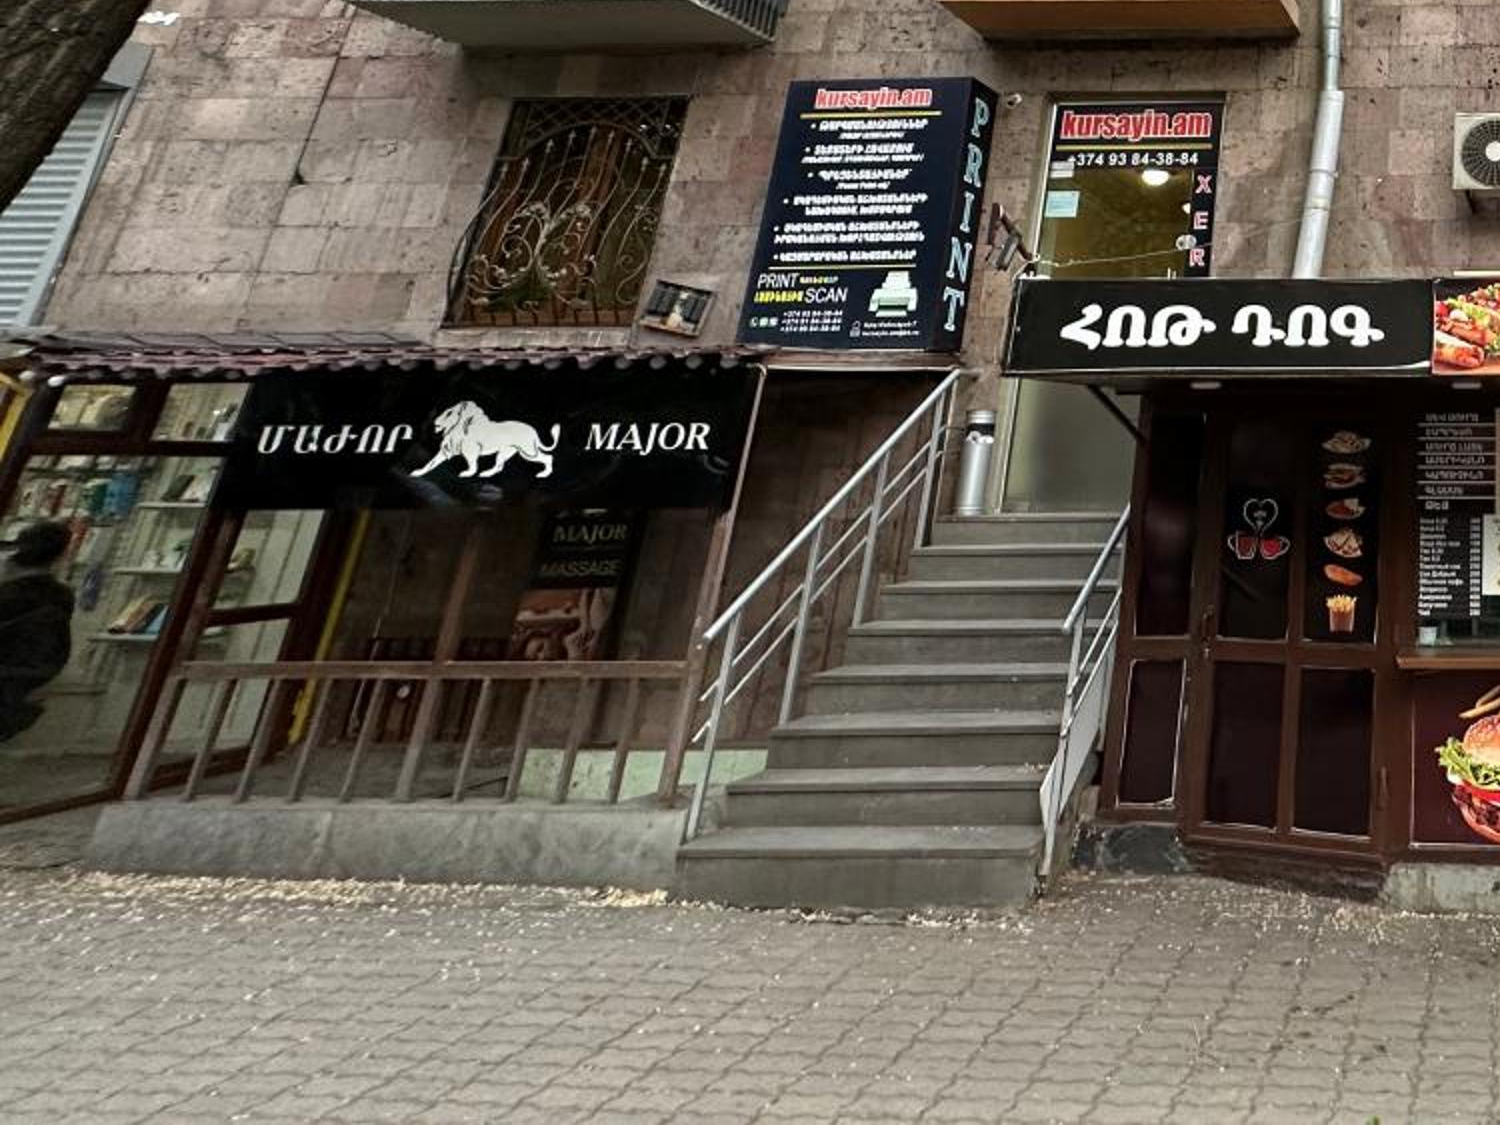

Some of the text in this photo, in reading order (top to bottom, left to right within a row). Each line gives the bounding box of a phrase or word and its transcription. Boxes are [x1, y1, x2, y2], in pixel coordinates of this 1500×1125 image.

[814, 86, 932, 110] kursayin.am
[1060, 109, 1212, 142] kursayin.am
[1067, 152, 1198, 166] +374 93 84-38-84
[942, 97, 990, 332] PRINT
[757, 273, 799, 289] PRINT
[804, 287, 848, 304] SCAN
[1060, 303, 1385, 351] ՀՈԹ ԴՈԳ
[257, 424, 413, 455] ՄԱԺՈՐ
[585, 422, 711, 456] MAJOR
[552, 523, 629, 544] MAJOR
